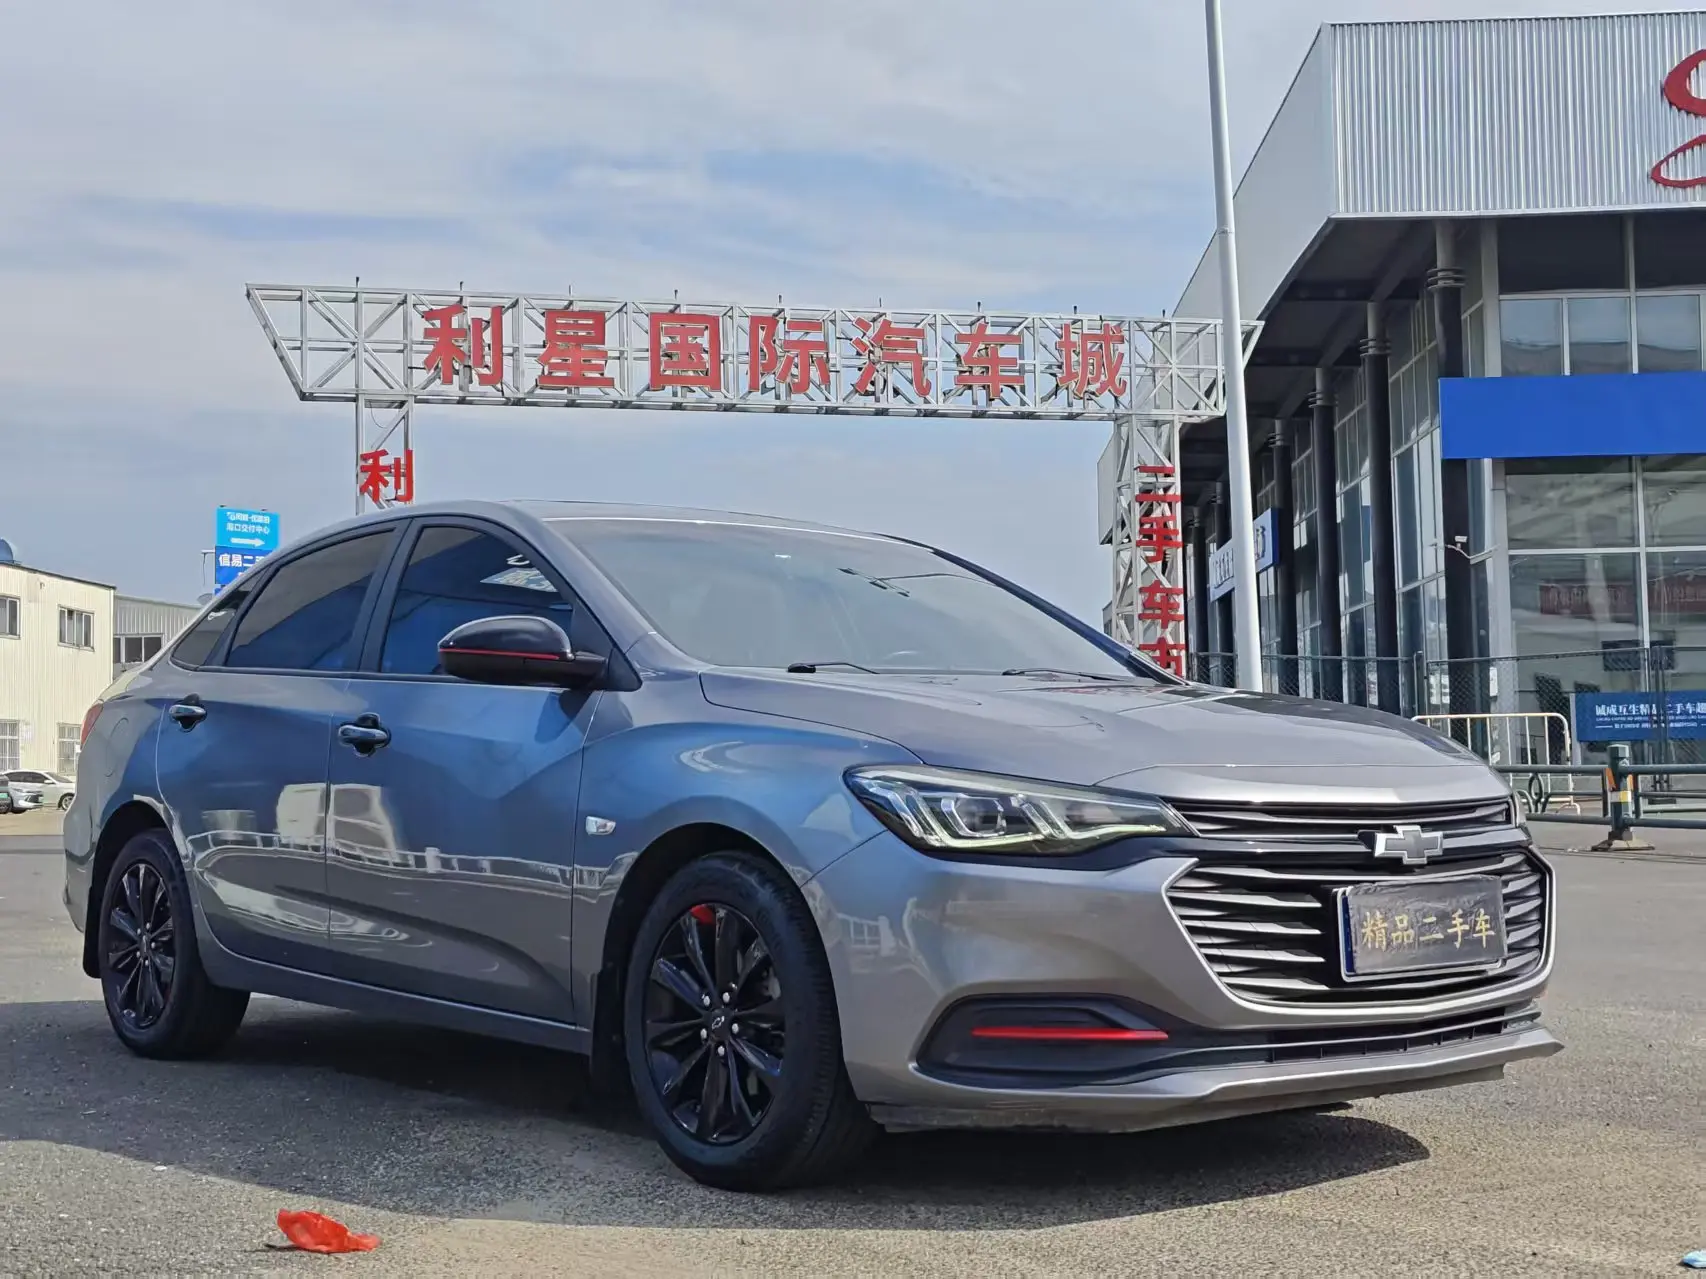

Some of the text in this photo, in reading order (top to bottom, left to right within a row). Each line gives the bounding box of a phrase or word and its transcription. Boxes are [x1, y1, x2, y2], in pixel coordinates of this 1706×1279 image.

[423, 304, 1127, 398] 利星国际汽车城
[360, 449, 413, 503] 利
[1361, 908, 1495, 951] 精品二手车
